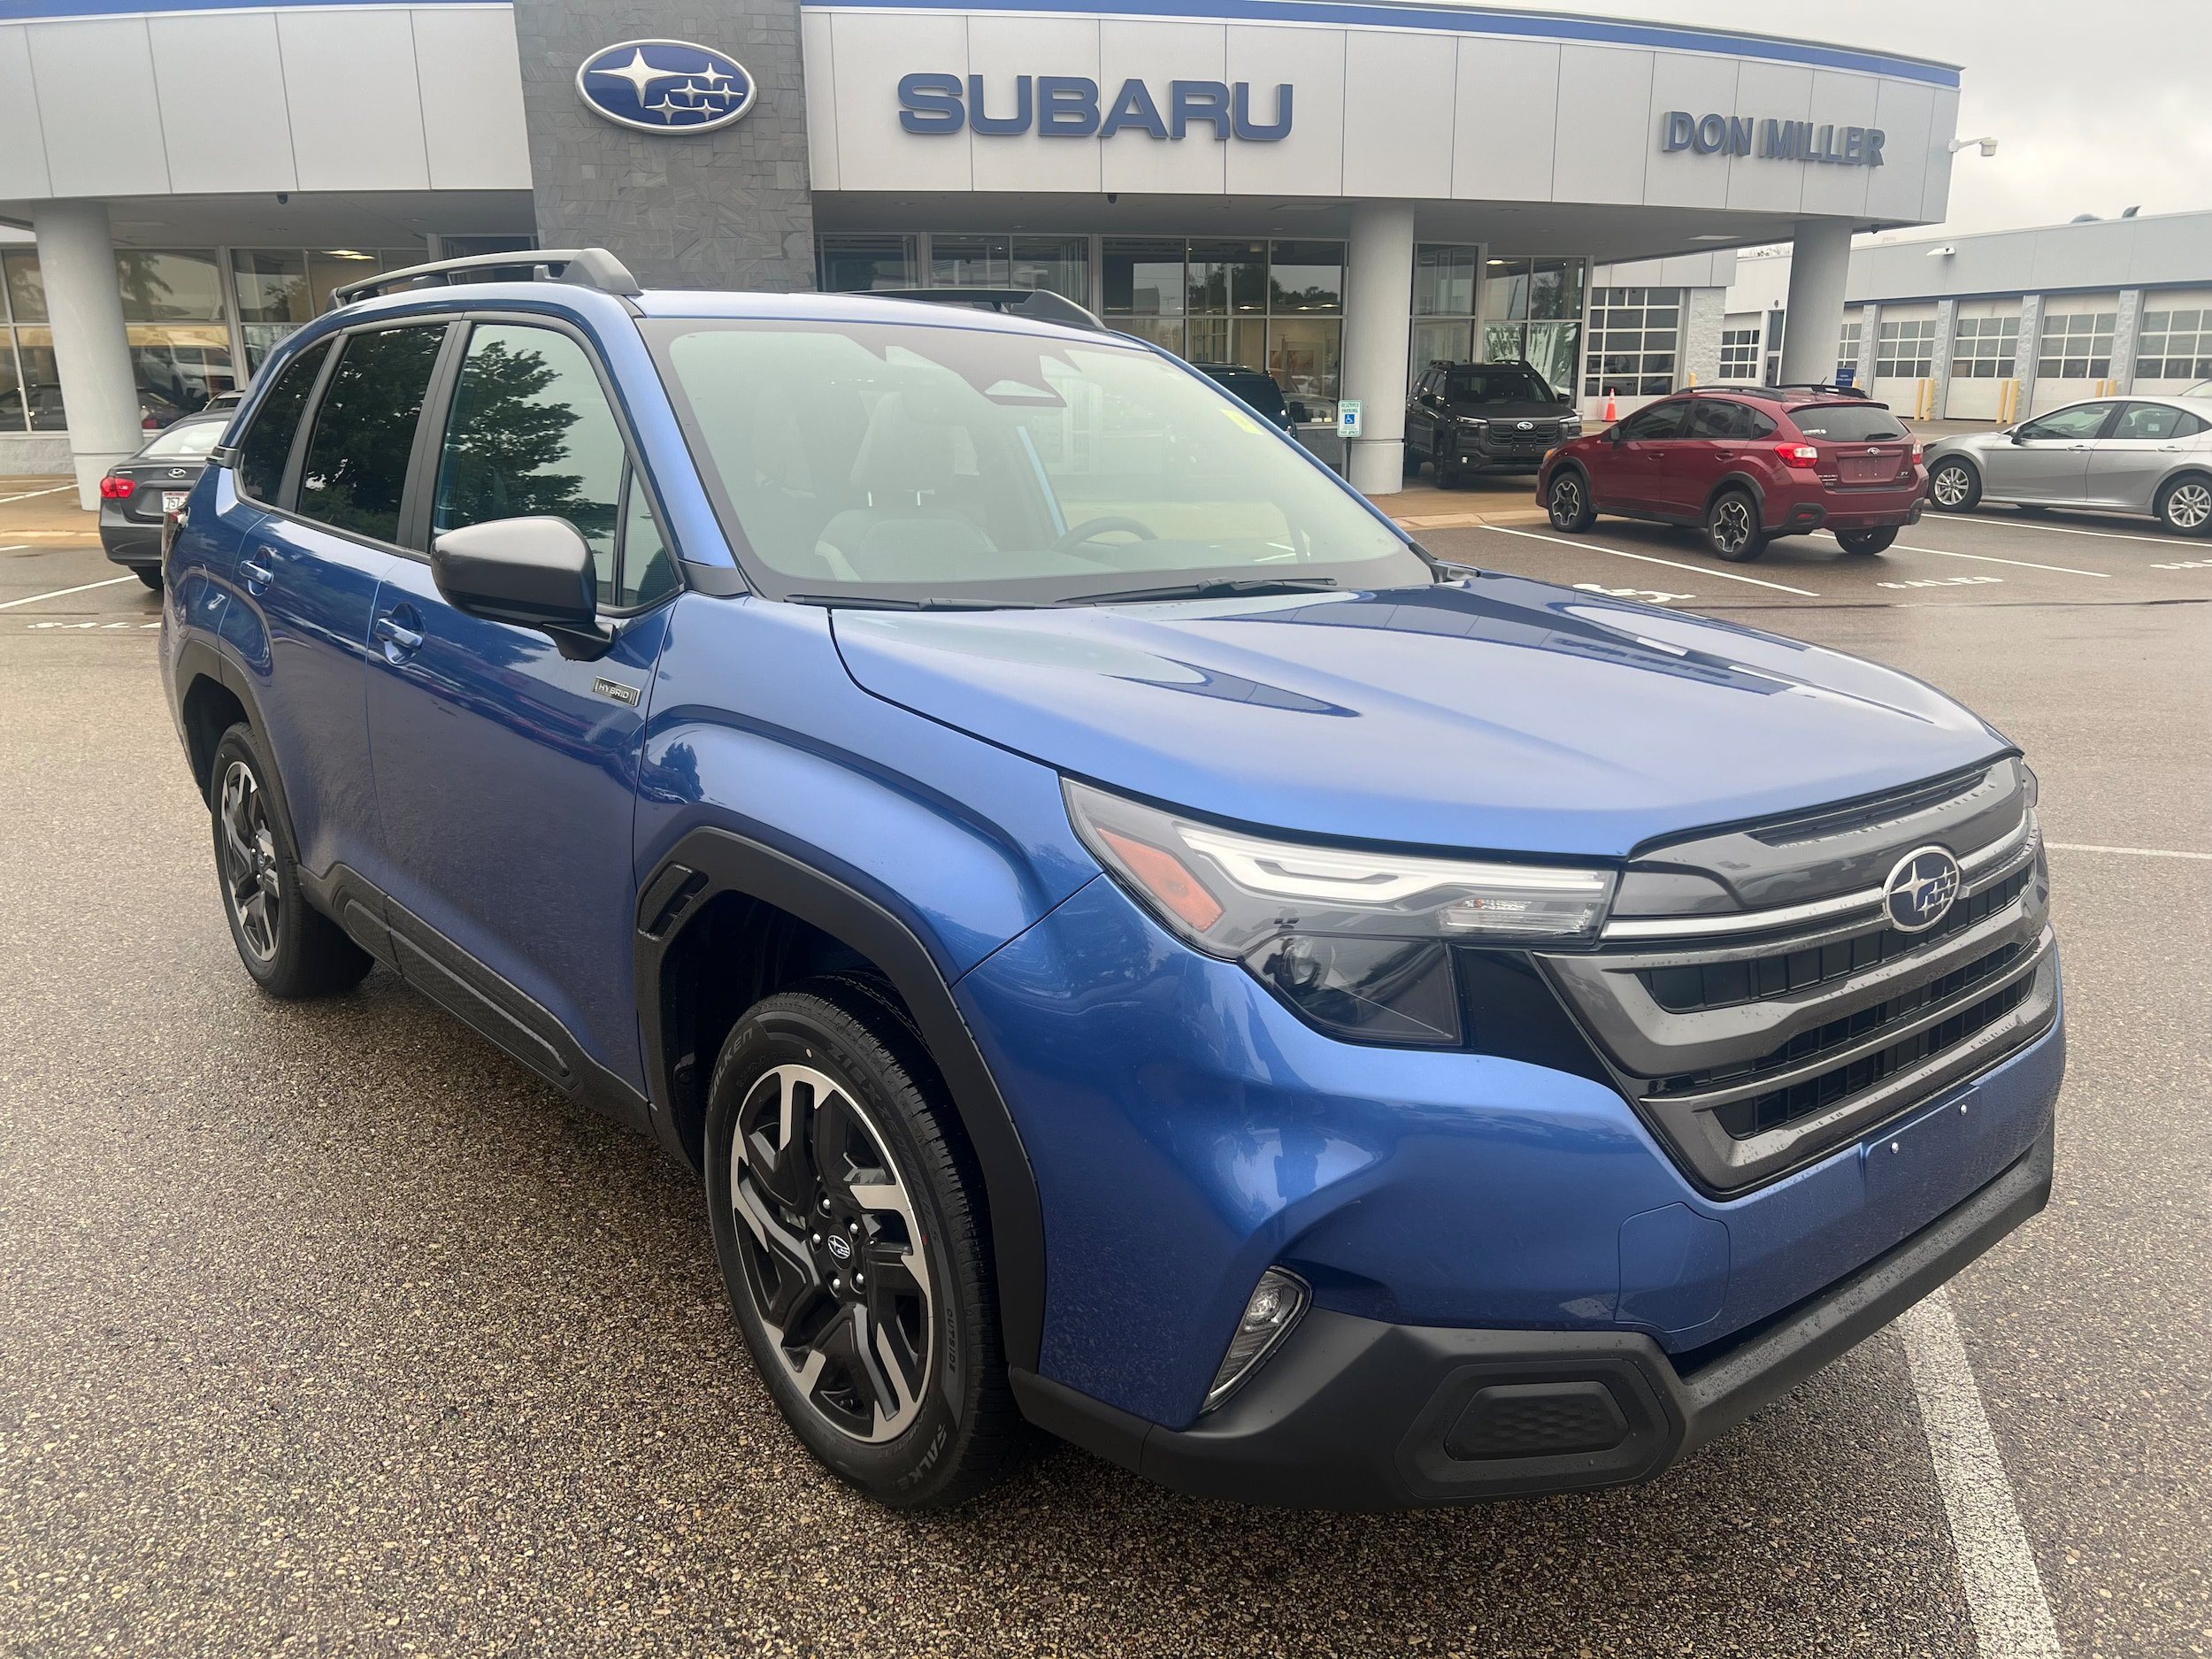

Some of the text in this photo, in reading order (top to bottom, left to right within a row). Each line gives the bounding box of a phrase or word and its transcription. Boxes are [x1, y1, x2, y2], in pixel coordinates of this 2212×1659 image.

[898, 73, 1294, 142] SUBARU
[1663, 111, 1886, 166] DON MILLER
[1876, 576, 2004, 589] SALES
[598, 682, 630, 699] HYBRID
[946, 1308, 956, 1373] OUTSIDE
